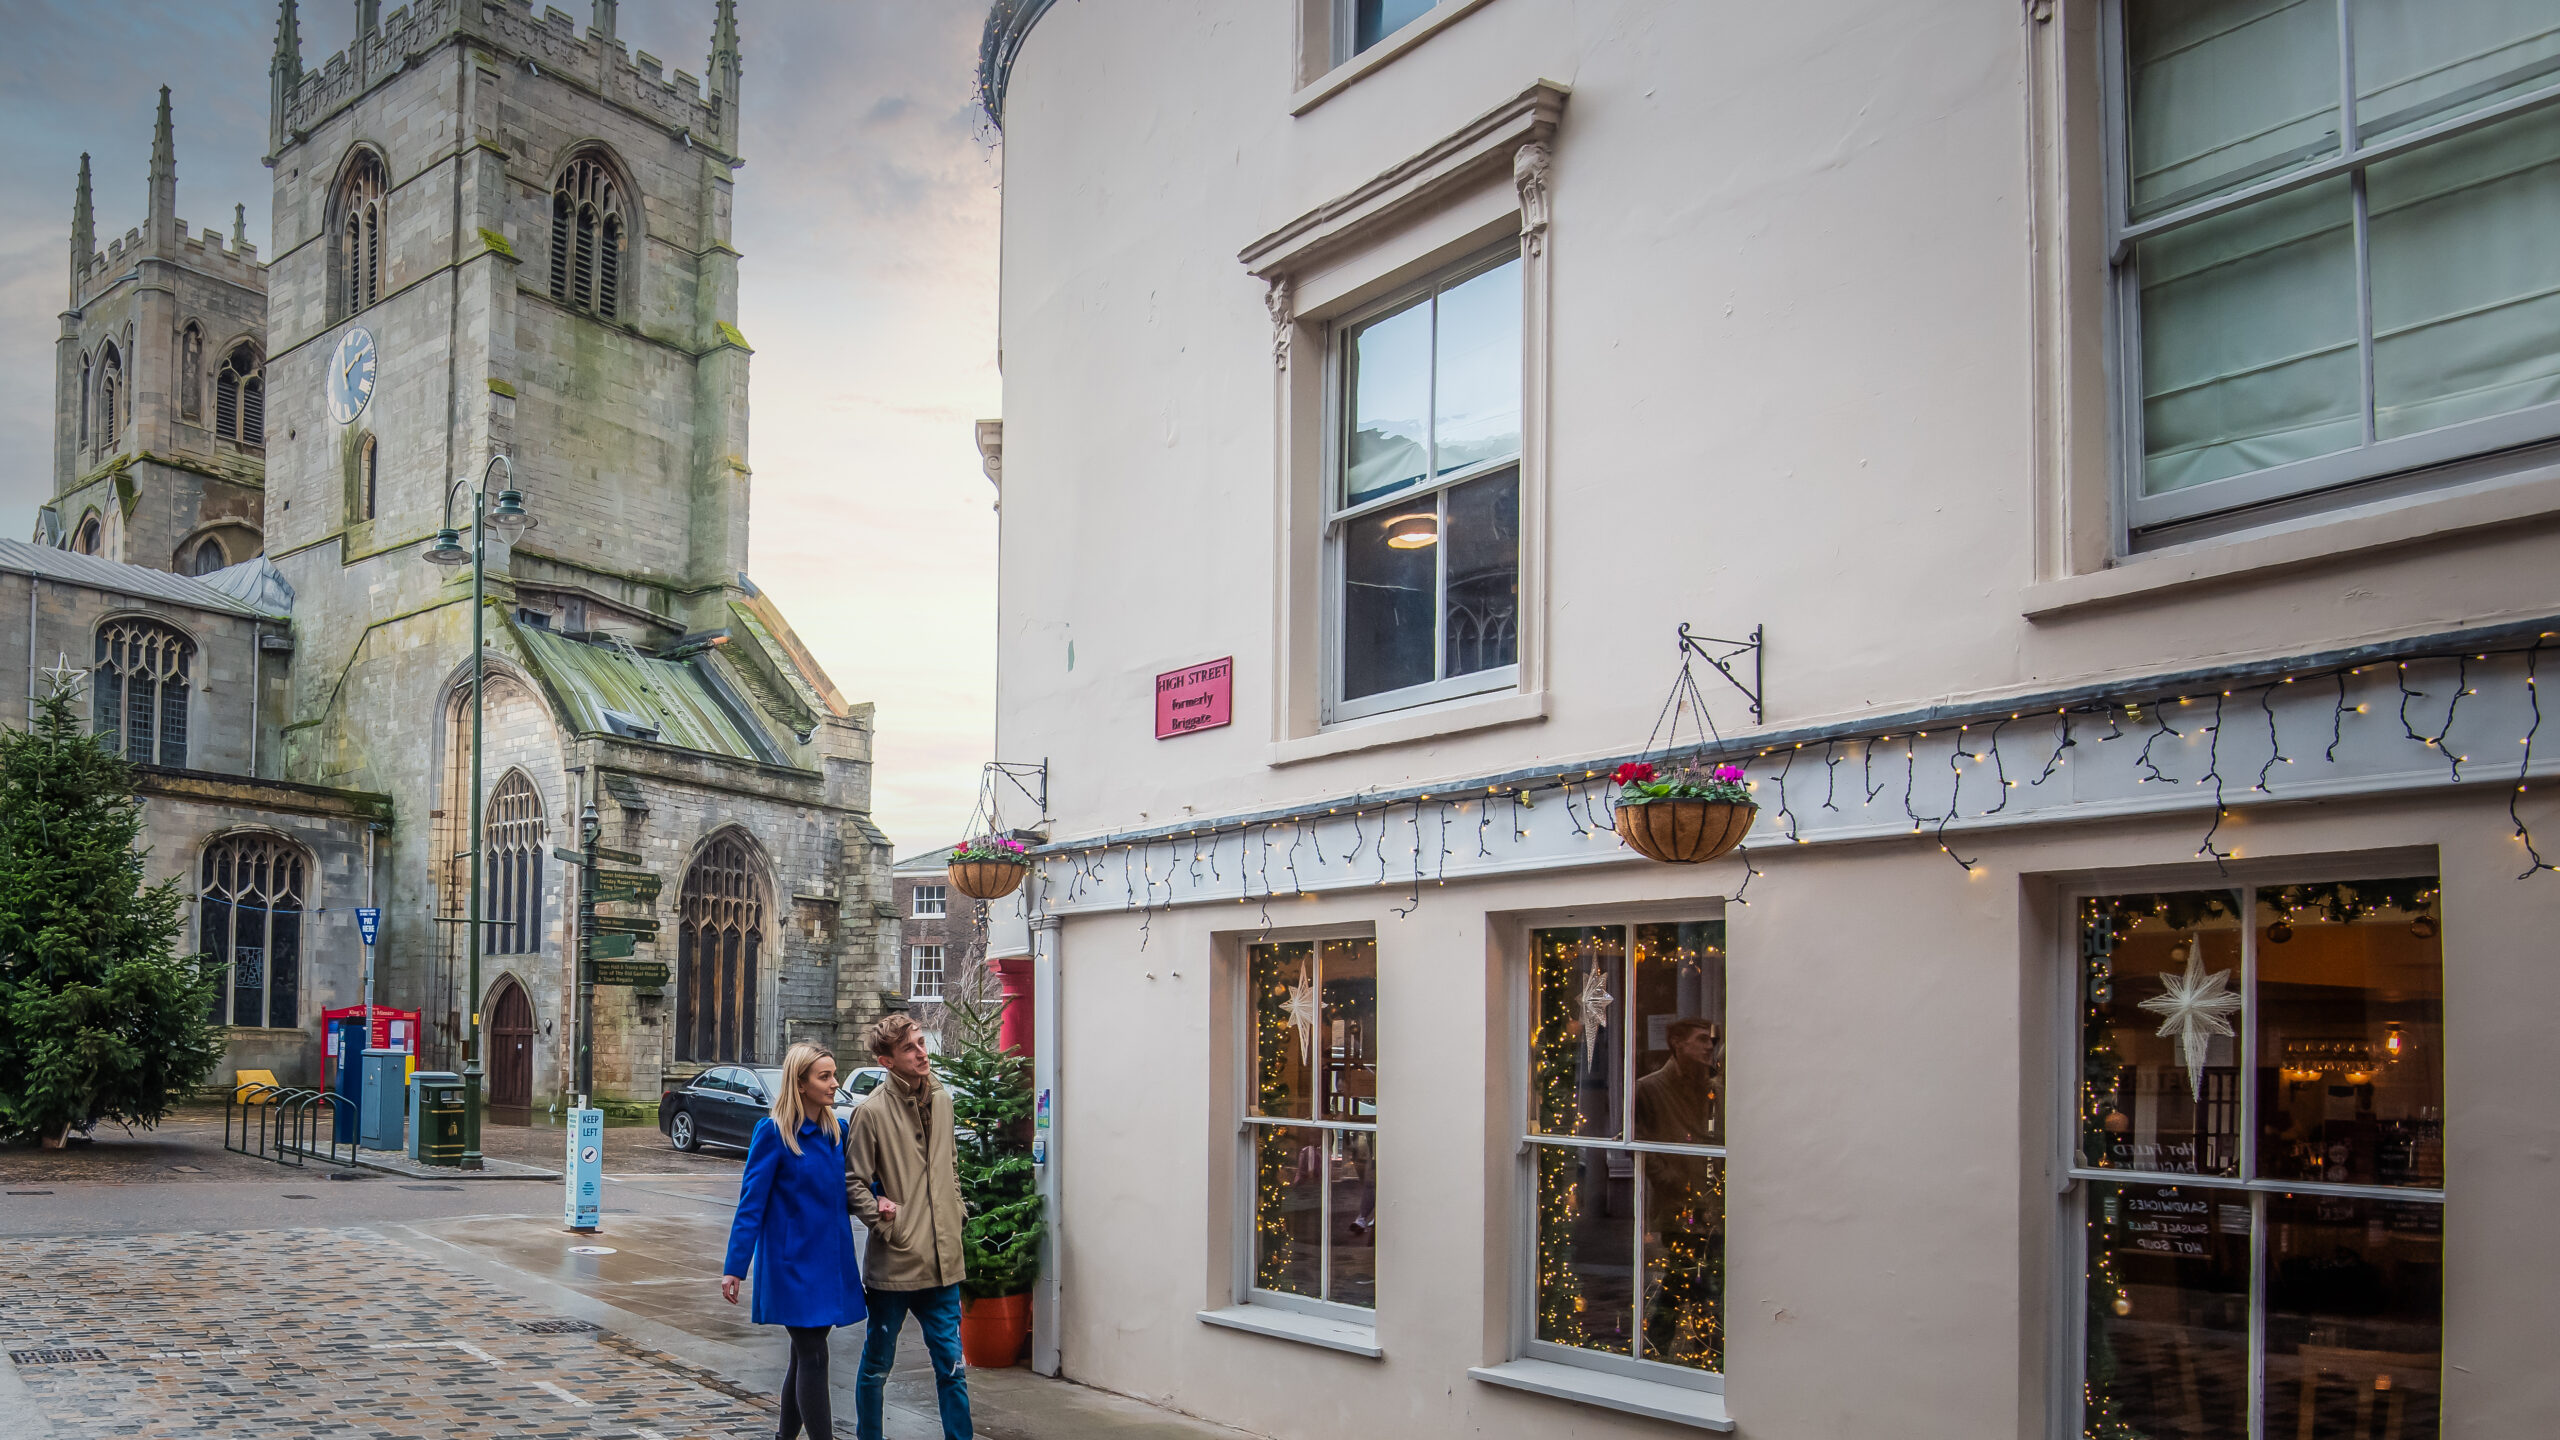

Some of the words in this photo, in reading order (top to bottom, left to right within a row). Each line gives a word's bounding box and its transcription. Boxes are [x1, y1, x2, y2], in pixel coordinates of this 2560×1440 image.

[1158, 675, 1184, 693] HIGH
[1188, 665, 1228, 685] STREET
[1172, 714, 1211, 730] Briggate
[583, 1115, 599, 1124] KEEP
[583, 1128, 598, 1136] LEFT
